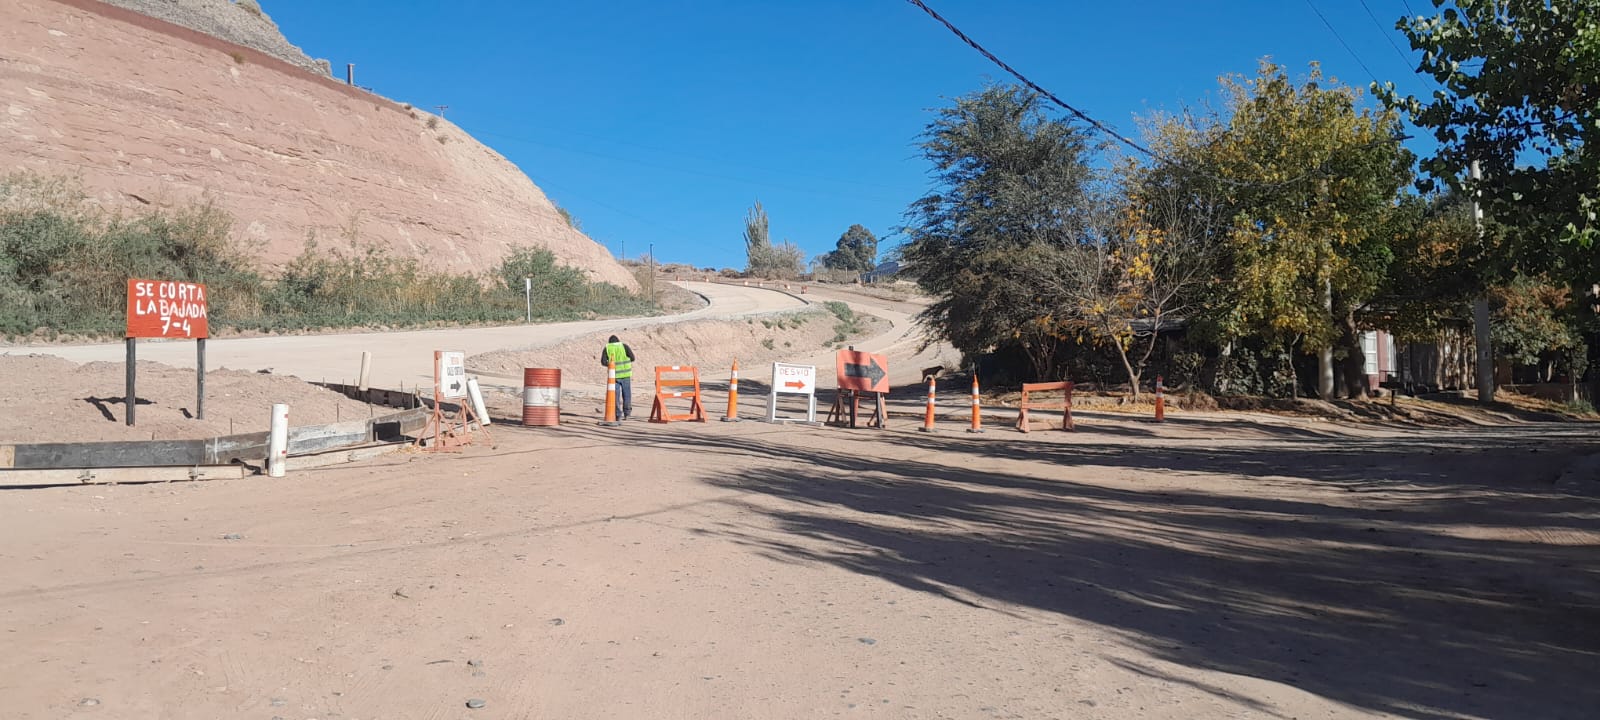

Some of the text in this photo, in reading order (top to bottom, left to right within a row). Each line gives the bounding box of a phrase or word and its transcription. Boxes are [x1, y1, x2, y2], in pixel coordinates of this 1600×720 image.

[136, 282, 204, 301] SE CORTA
[136, 299, 207, 318] LA BAJADA
[160, 317, 190, 336] 7-4
[779, 367, 809, 376] DESVIO
